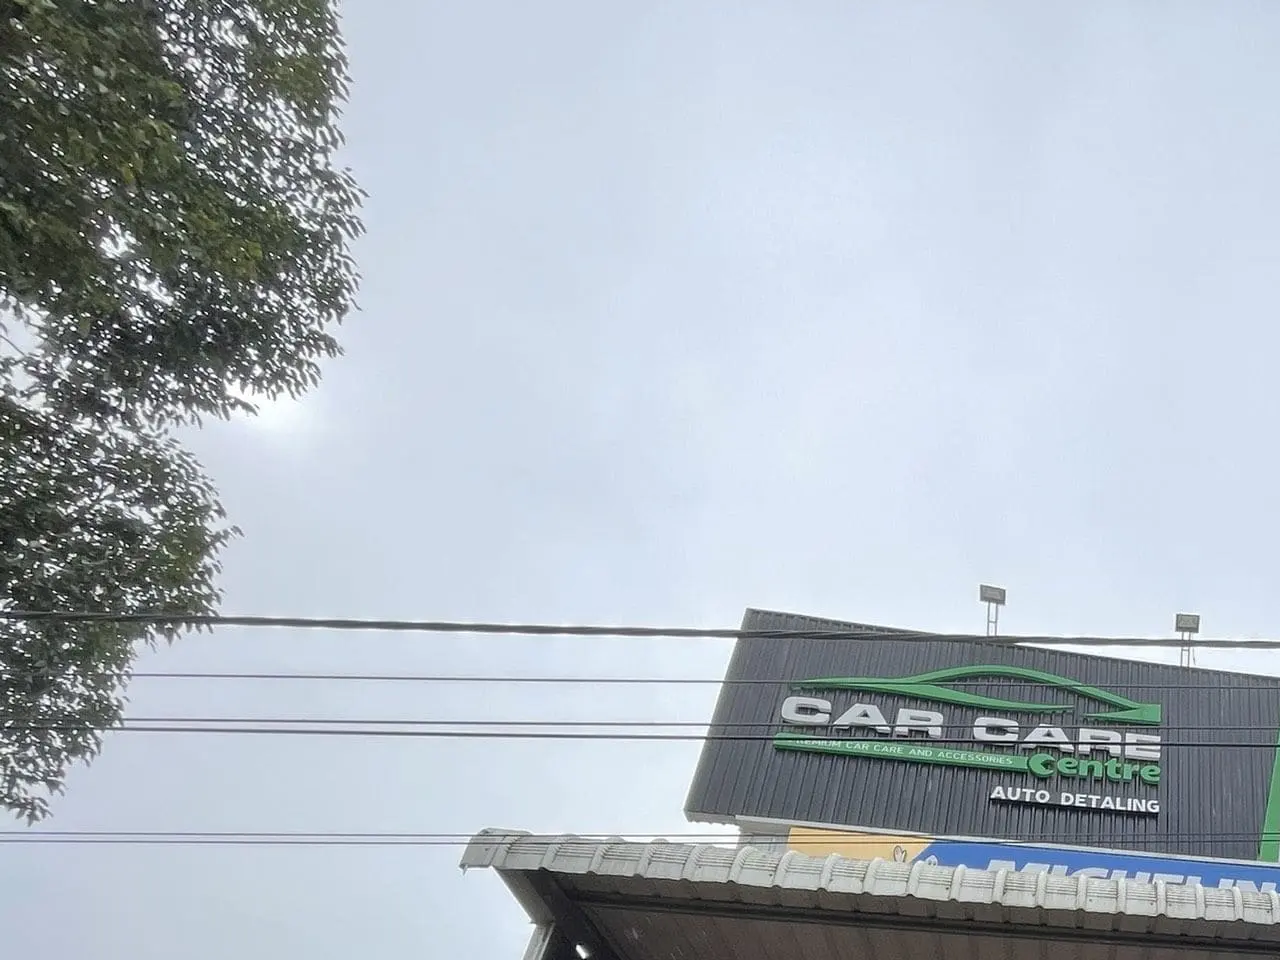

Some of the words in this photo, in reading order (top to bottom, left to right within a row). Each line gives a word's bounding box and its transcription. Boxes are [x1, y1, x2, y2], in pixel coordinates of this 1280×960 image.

[782, 697, 944, 739] CAR
[973, 717, 1161, 761] CARE
[846, 740, 870, 750] CAR
[873, 743, 904, 754] CARE
[908, 748, 933, 757] AND
[937, 751, 1013, 766] ACCESSORIES
[1029, 753, 1161, 785] Centre
[990, 786, 1050, 803] AUTO
[1060, 792, 1160, 814] DETALING
